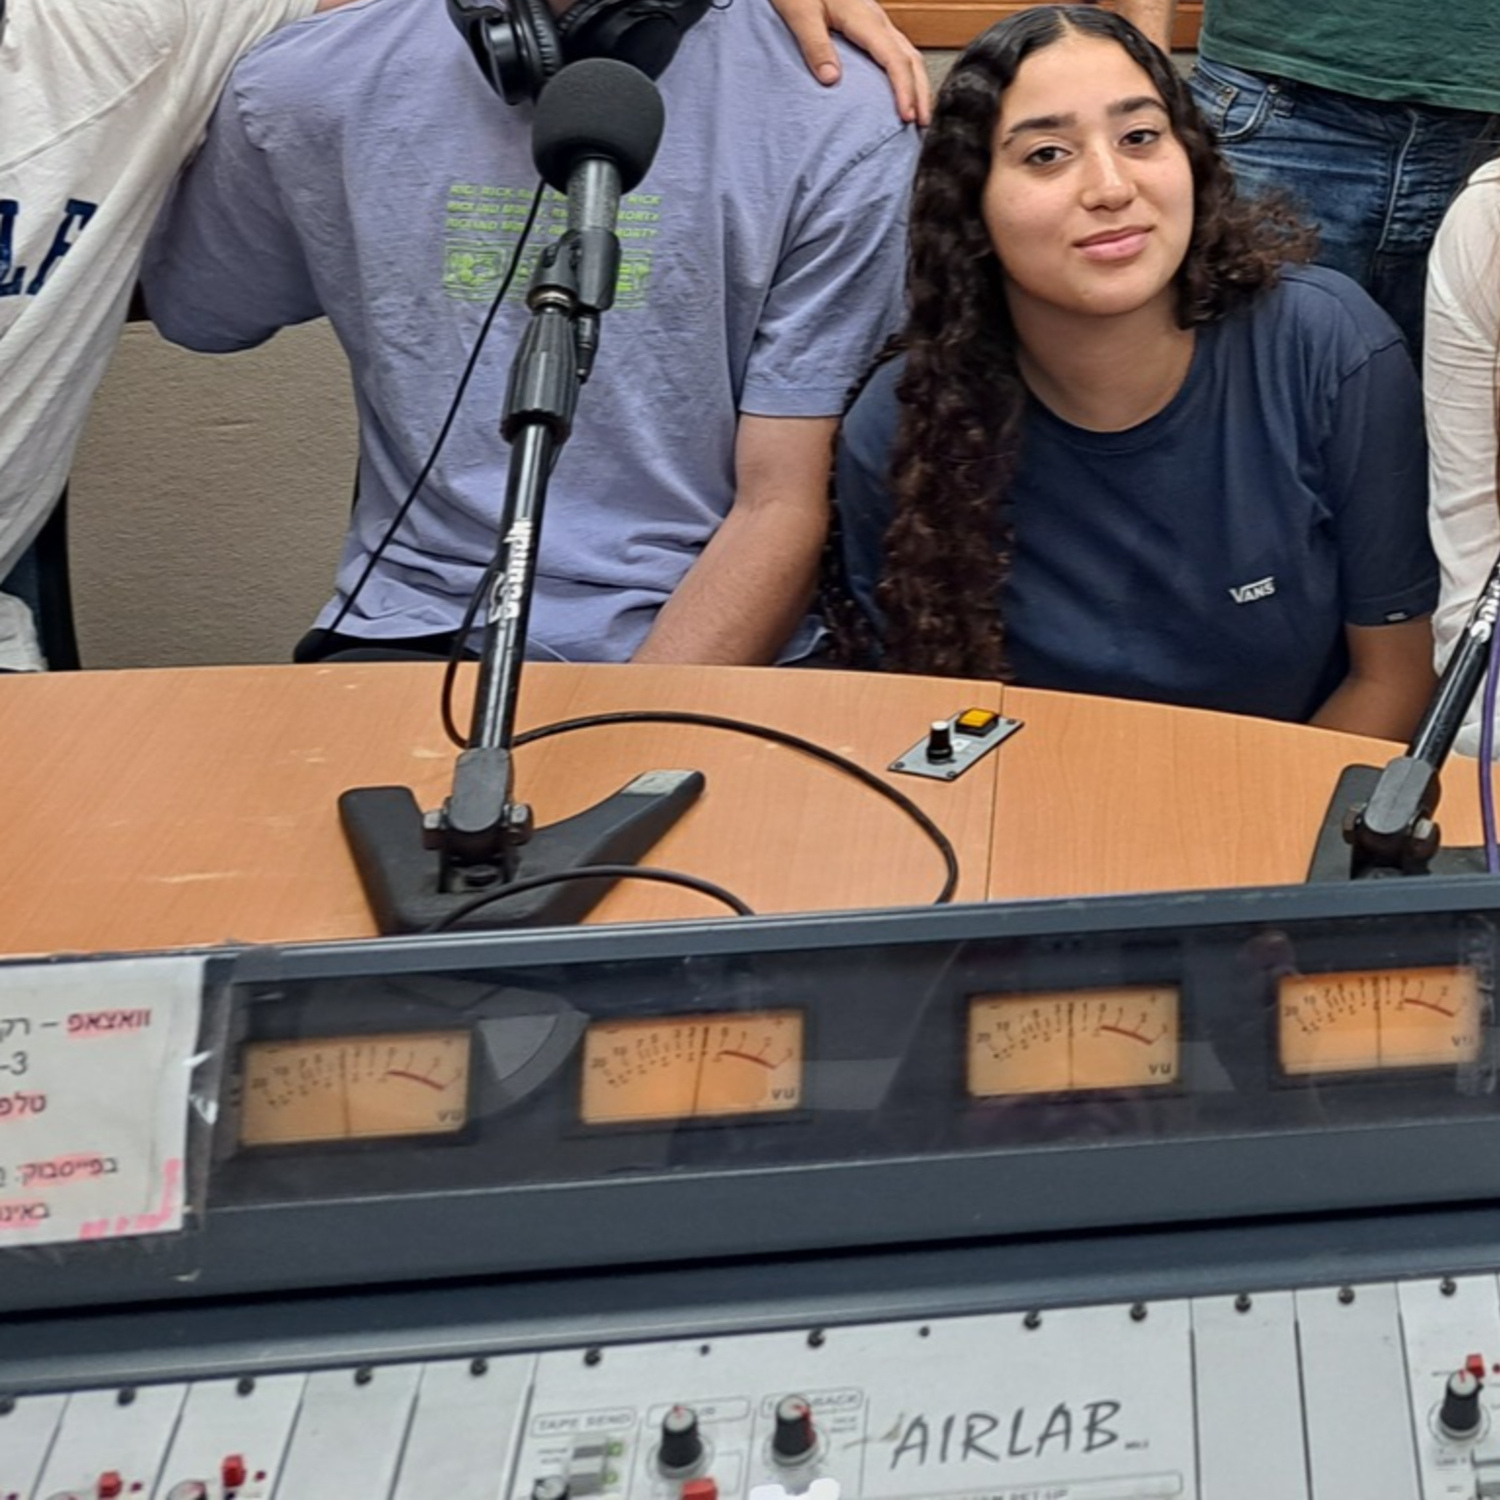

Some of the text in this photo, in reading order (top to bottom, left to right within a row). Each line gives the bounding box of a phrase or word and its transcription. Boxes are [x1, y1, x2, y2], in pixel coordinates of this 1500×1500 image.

[1228, 575, 1276, 604] VANS
[1148, 1062, 1172, 1076] VU
[771, 1088, 796, 1100] VU
[889, 1399, 1121, 1470] AIRLAB
